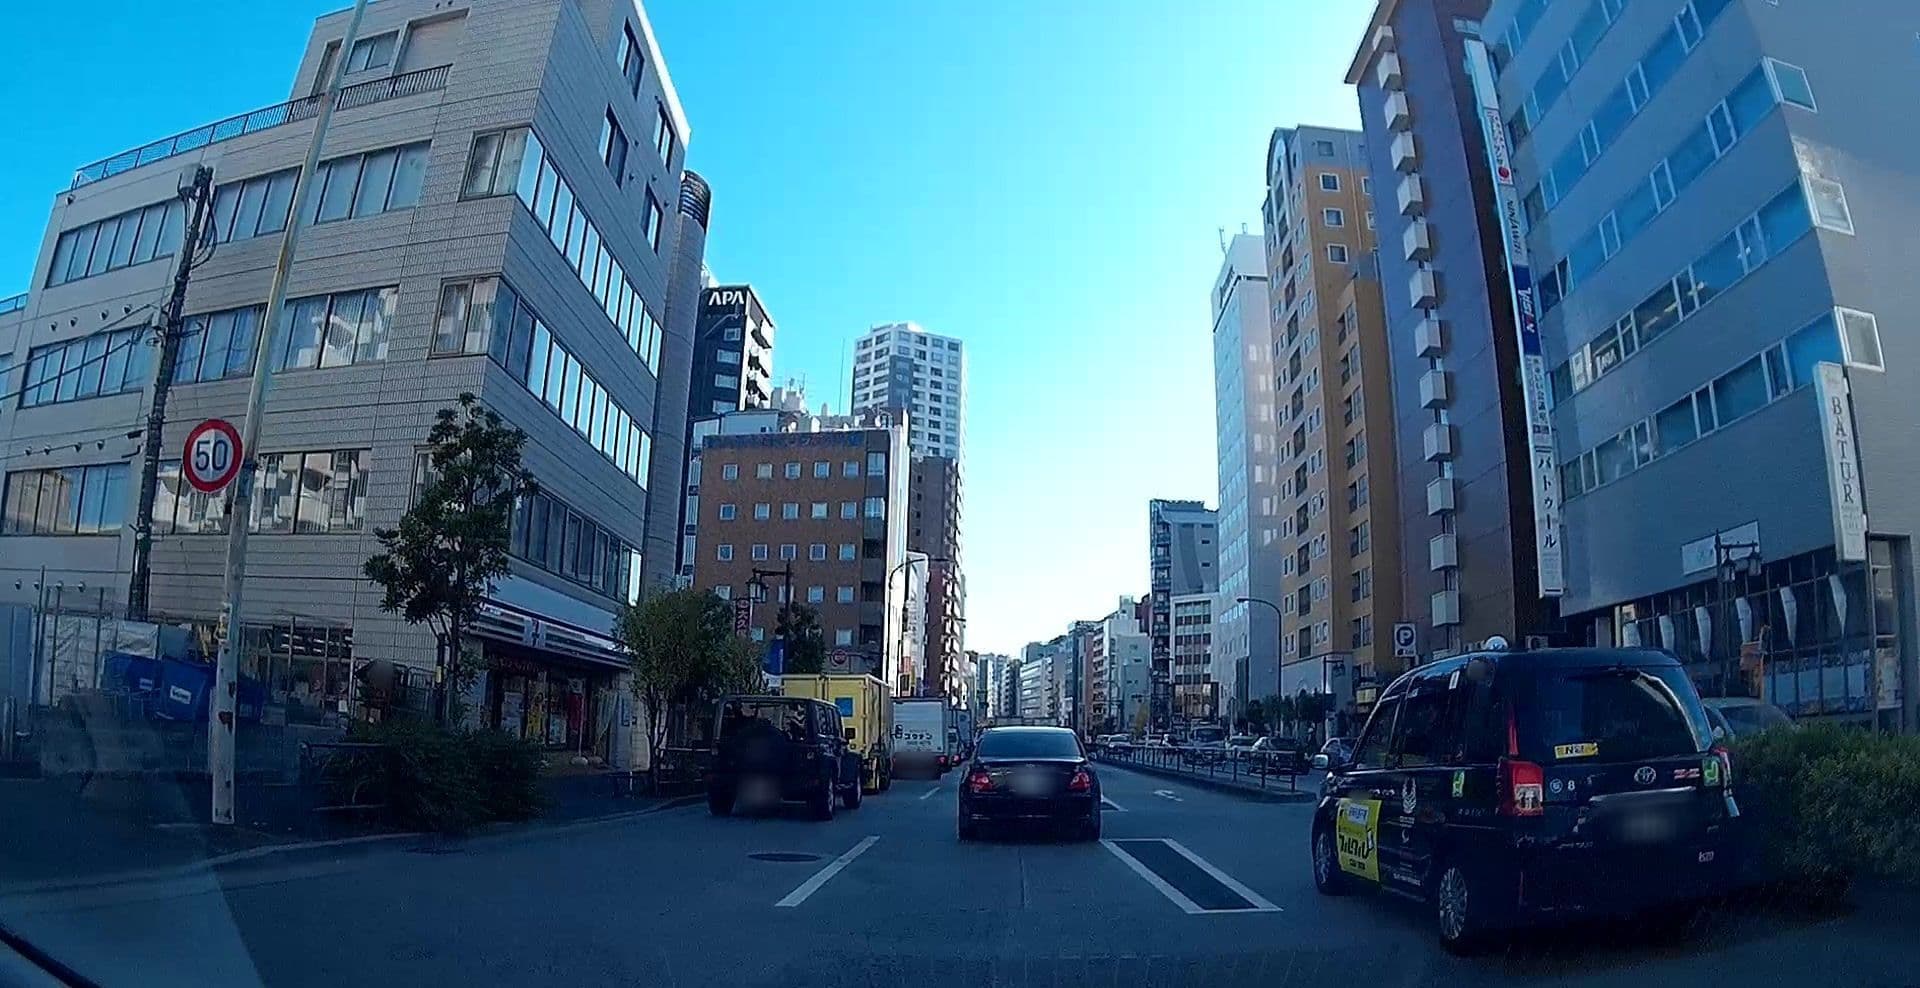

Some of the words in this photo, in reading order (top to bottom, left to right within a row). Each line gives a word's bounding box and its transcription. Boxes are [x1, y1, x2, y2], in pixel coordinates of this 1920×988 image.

[708, 291, 744, 305] APA
[195, 440, 228, 471] 50
[1832, 397, 1855, 504] BATUR
[1399, 630, 1412, 644] P
[1567, 779, 1576, 790] 8
